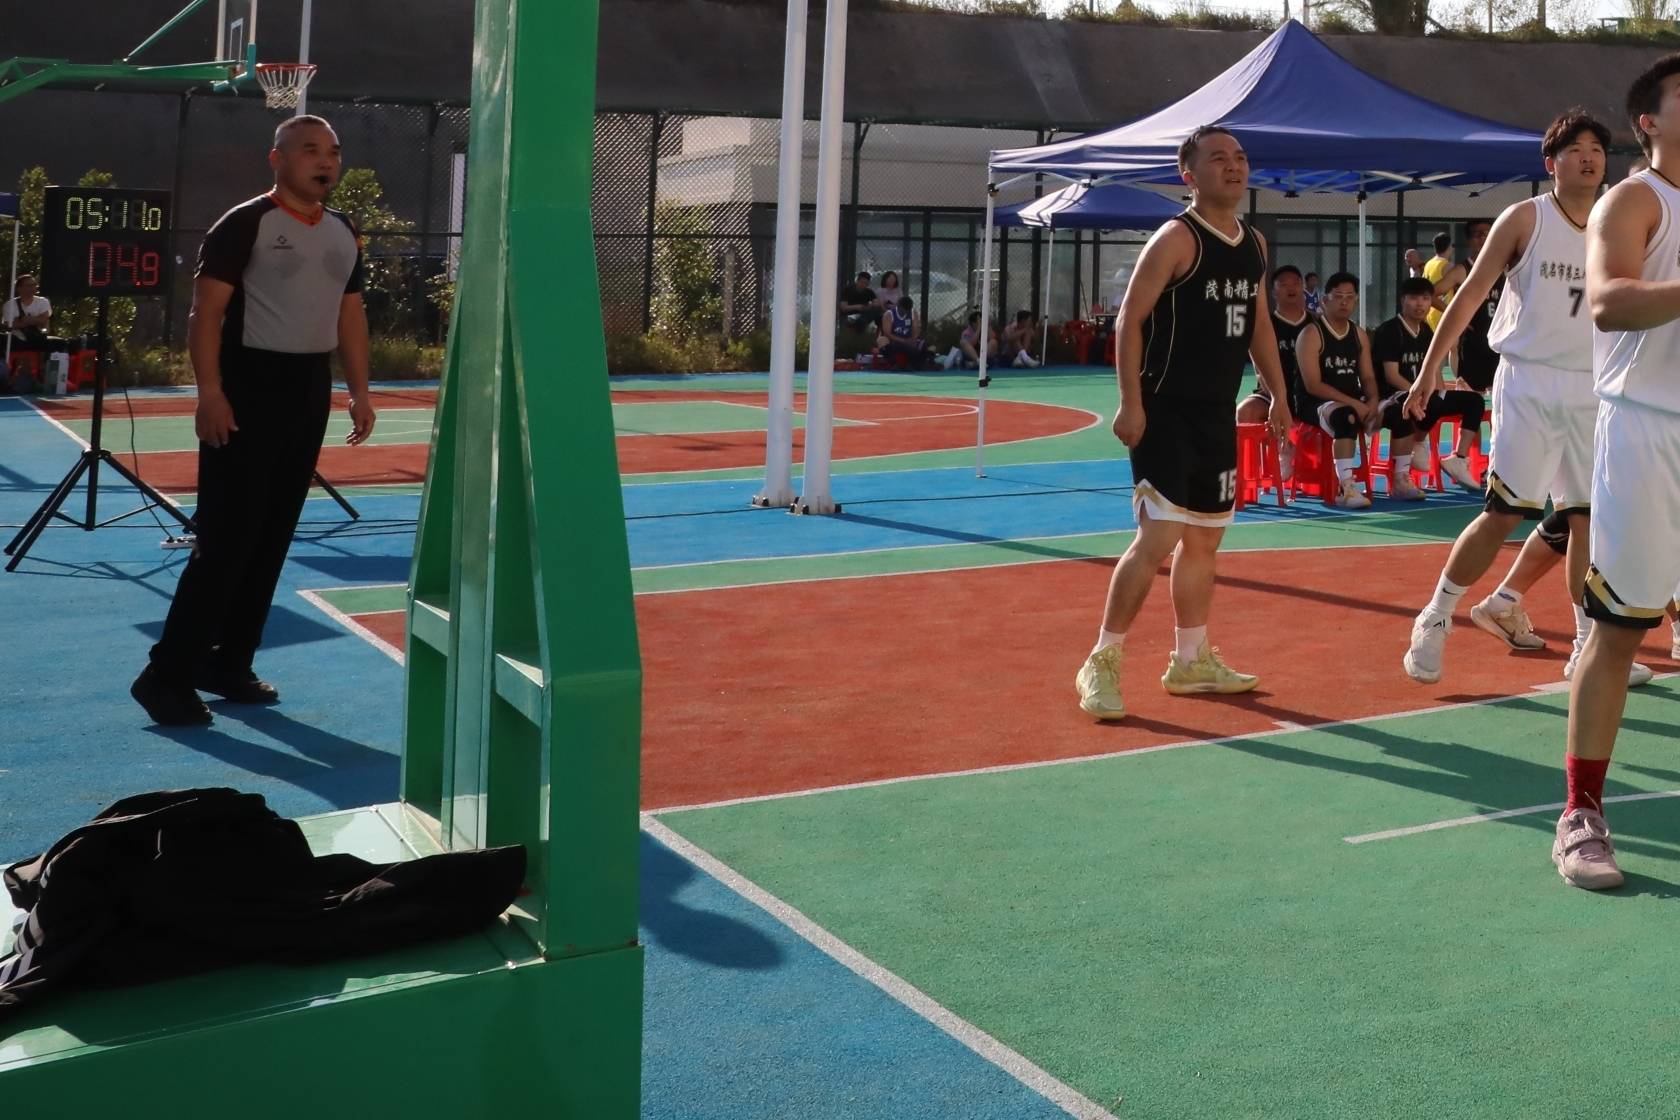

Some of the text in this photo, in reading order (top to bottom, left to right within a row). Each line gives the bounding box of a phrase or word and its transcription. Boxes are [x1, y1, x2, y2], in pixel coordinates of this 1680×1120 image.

[88, 241, 160, 286] 04.9
[1568, 286, 1585, 318] 7
[1225, 304, 1247, 337] 15
